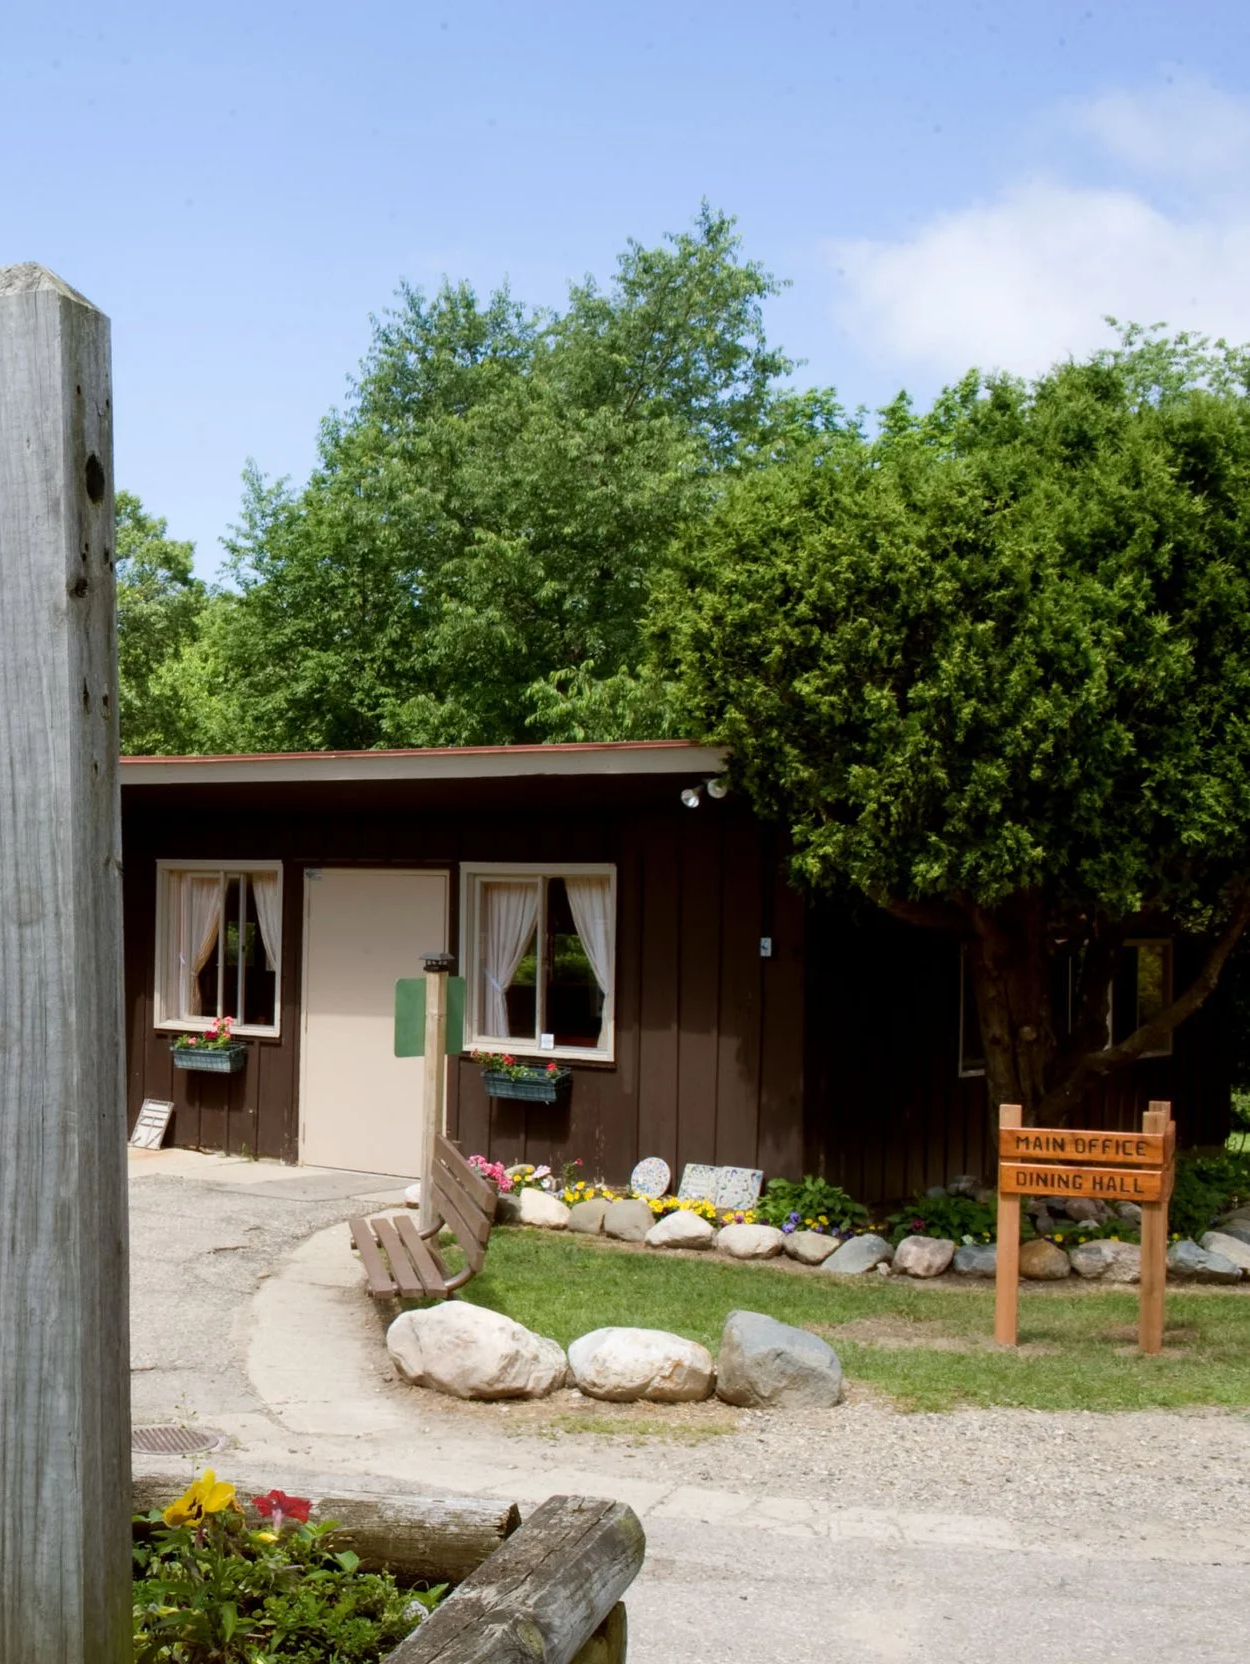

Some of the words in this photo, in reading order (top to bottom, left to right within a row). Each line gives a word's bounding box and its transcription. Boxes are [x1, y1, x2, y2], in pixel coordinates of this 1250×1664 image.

[1015, 1135, 1066, 1153] MAIN
[1074, 1138, 1148, 1157] OFFICE
[1015, 1171, 1084, 1190] DINING
[1092, 1175, 1145, 1194] HALL
